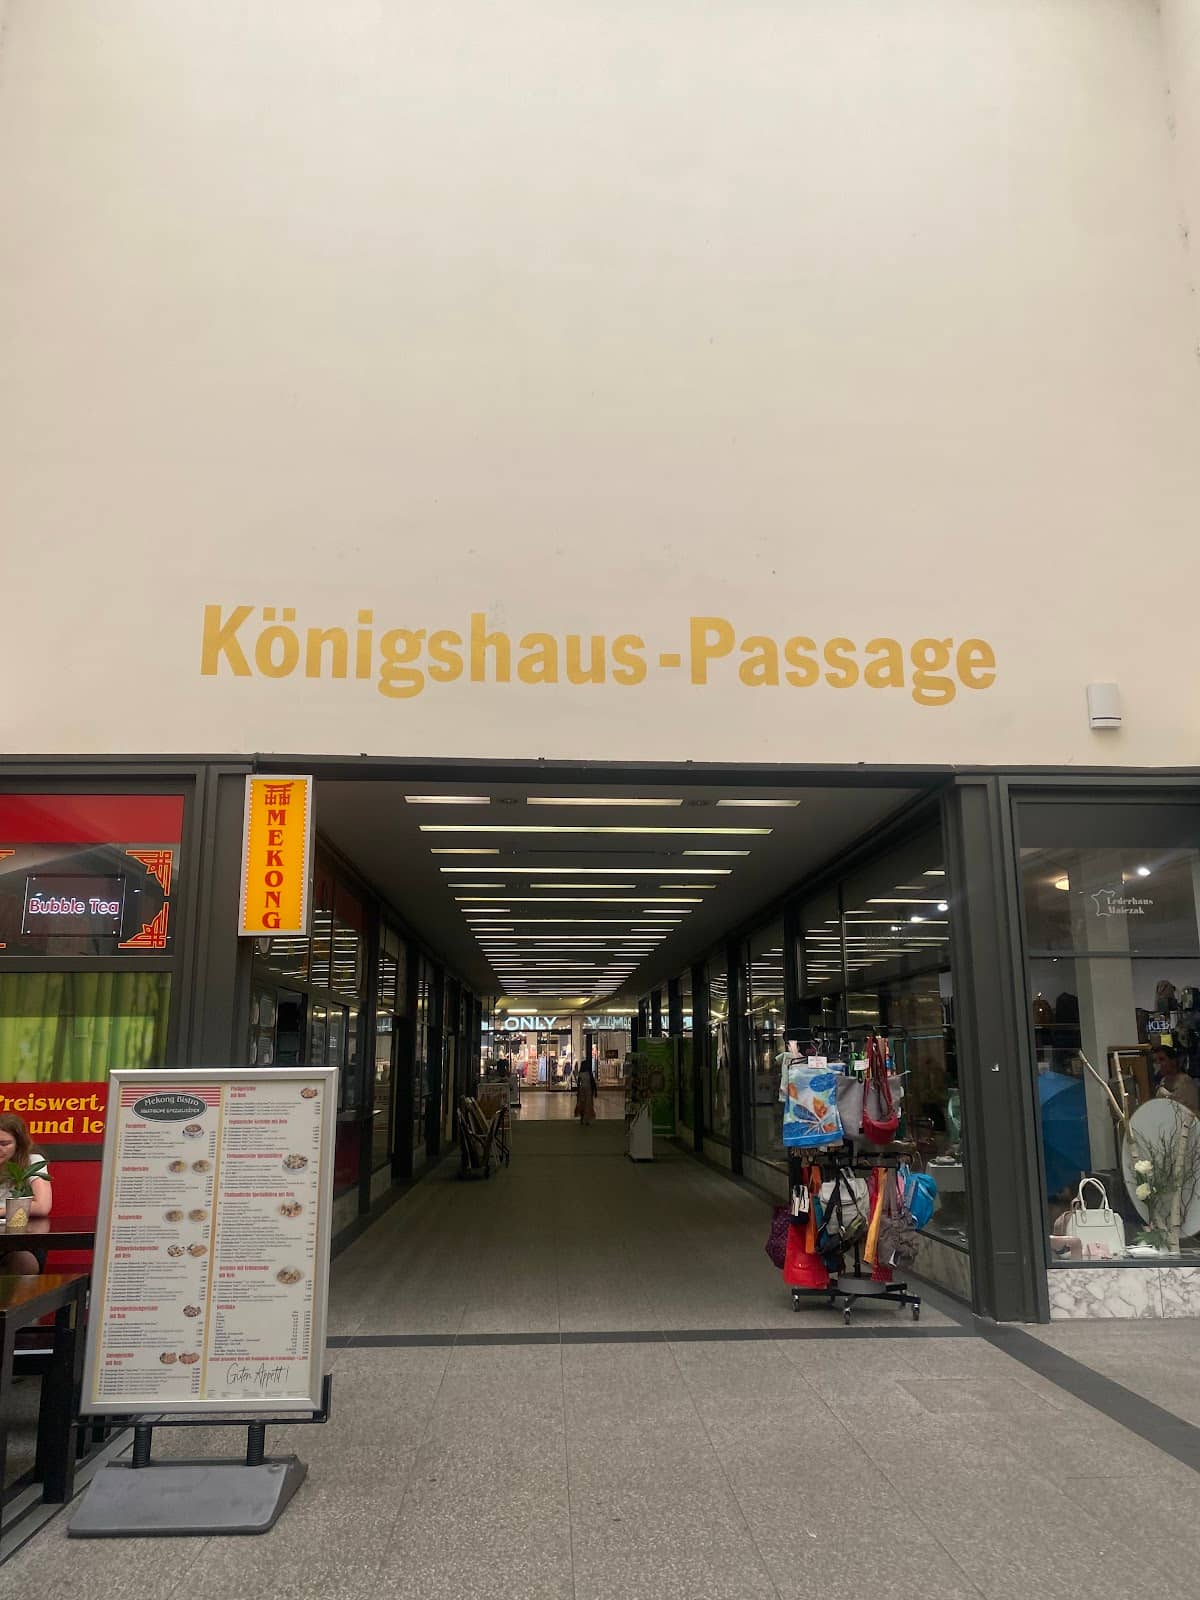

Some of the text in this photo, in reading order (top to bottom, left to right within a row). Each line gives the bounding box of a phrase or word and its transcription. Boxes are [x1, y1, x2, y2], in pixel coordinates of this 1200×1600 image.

[262, 809, 287, 929] MEKONG
[29, 897, 119, 915] Bubble Tea
[504, 1016, 557, 1031] ONLY
[0, 1093, 105, 1112] reiswert,
[144, 1096, 175, 1107] Mekong
[29, 1117, 105, 1134] und le
